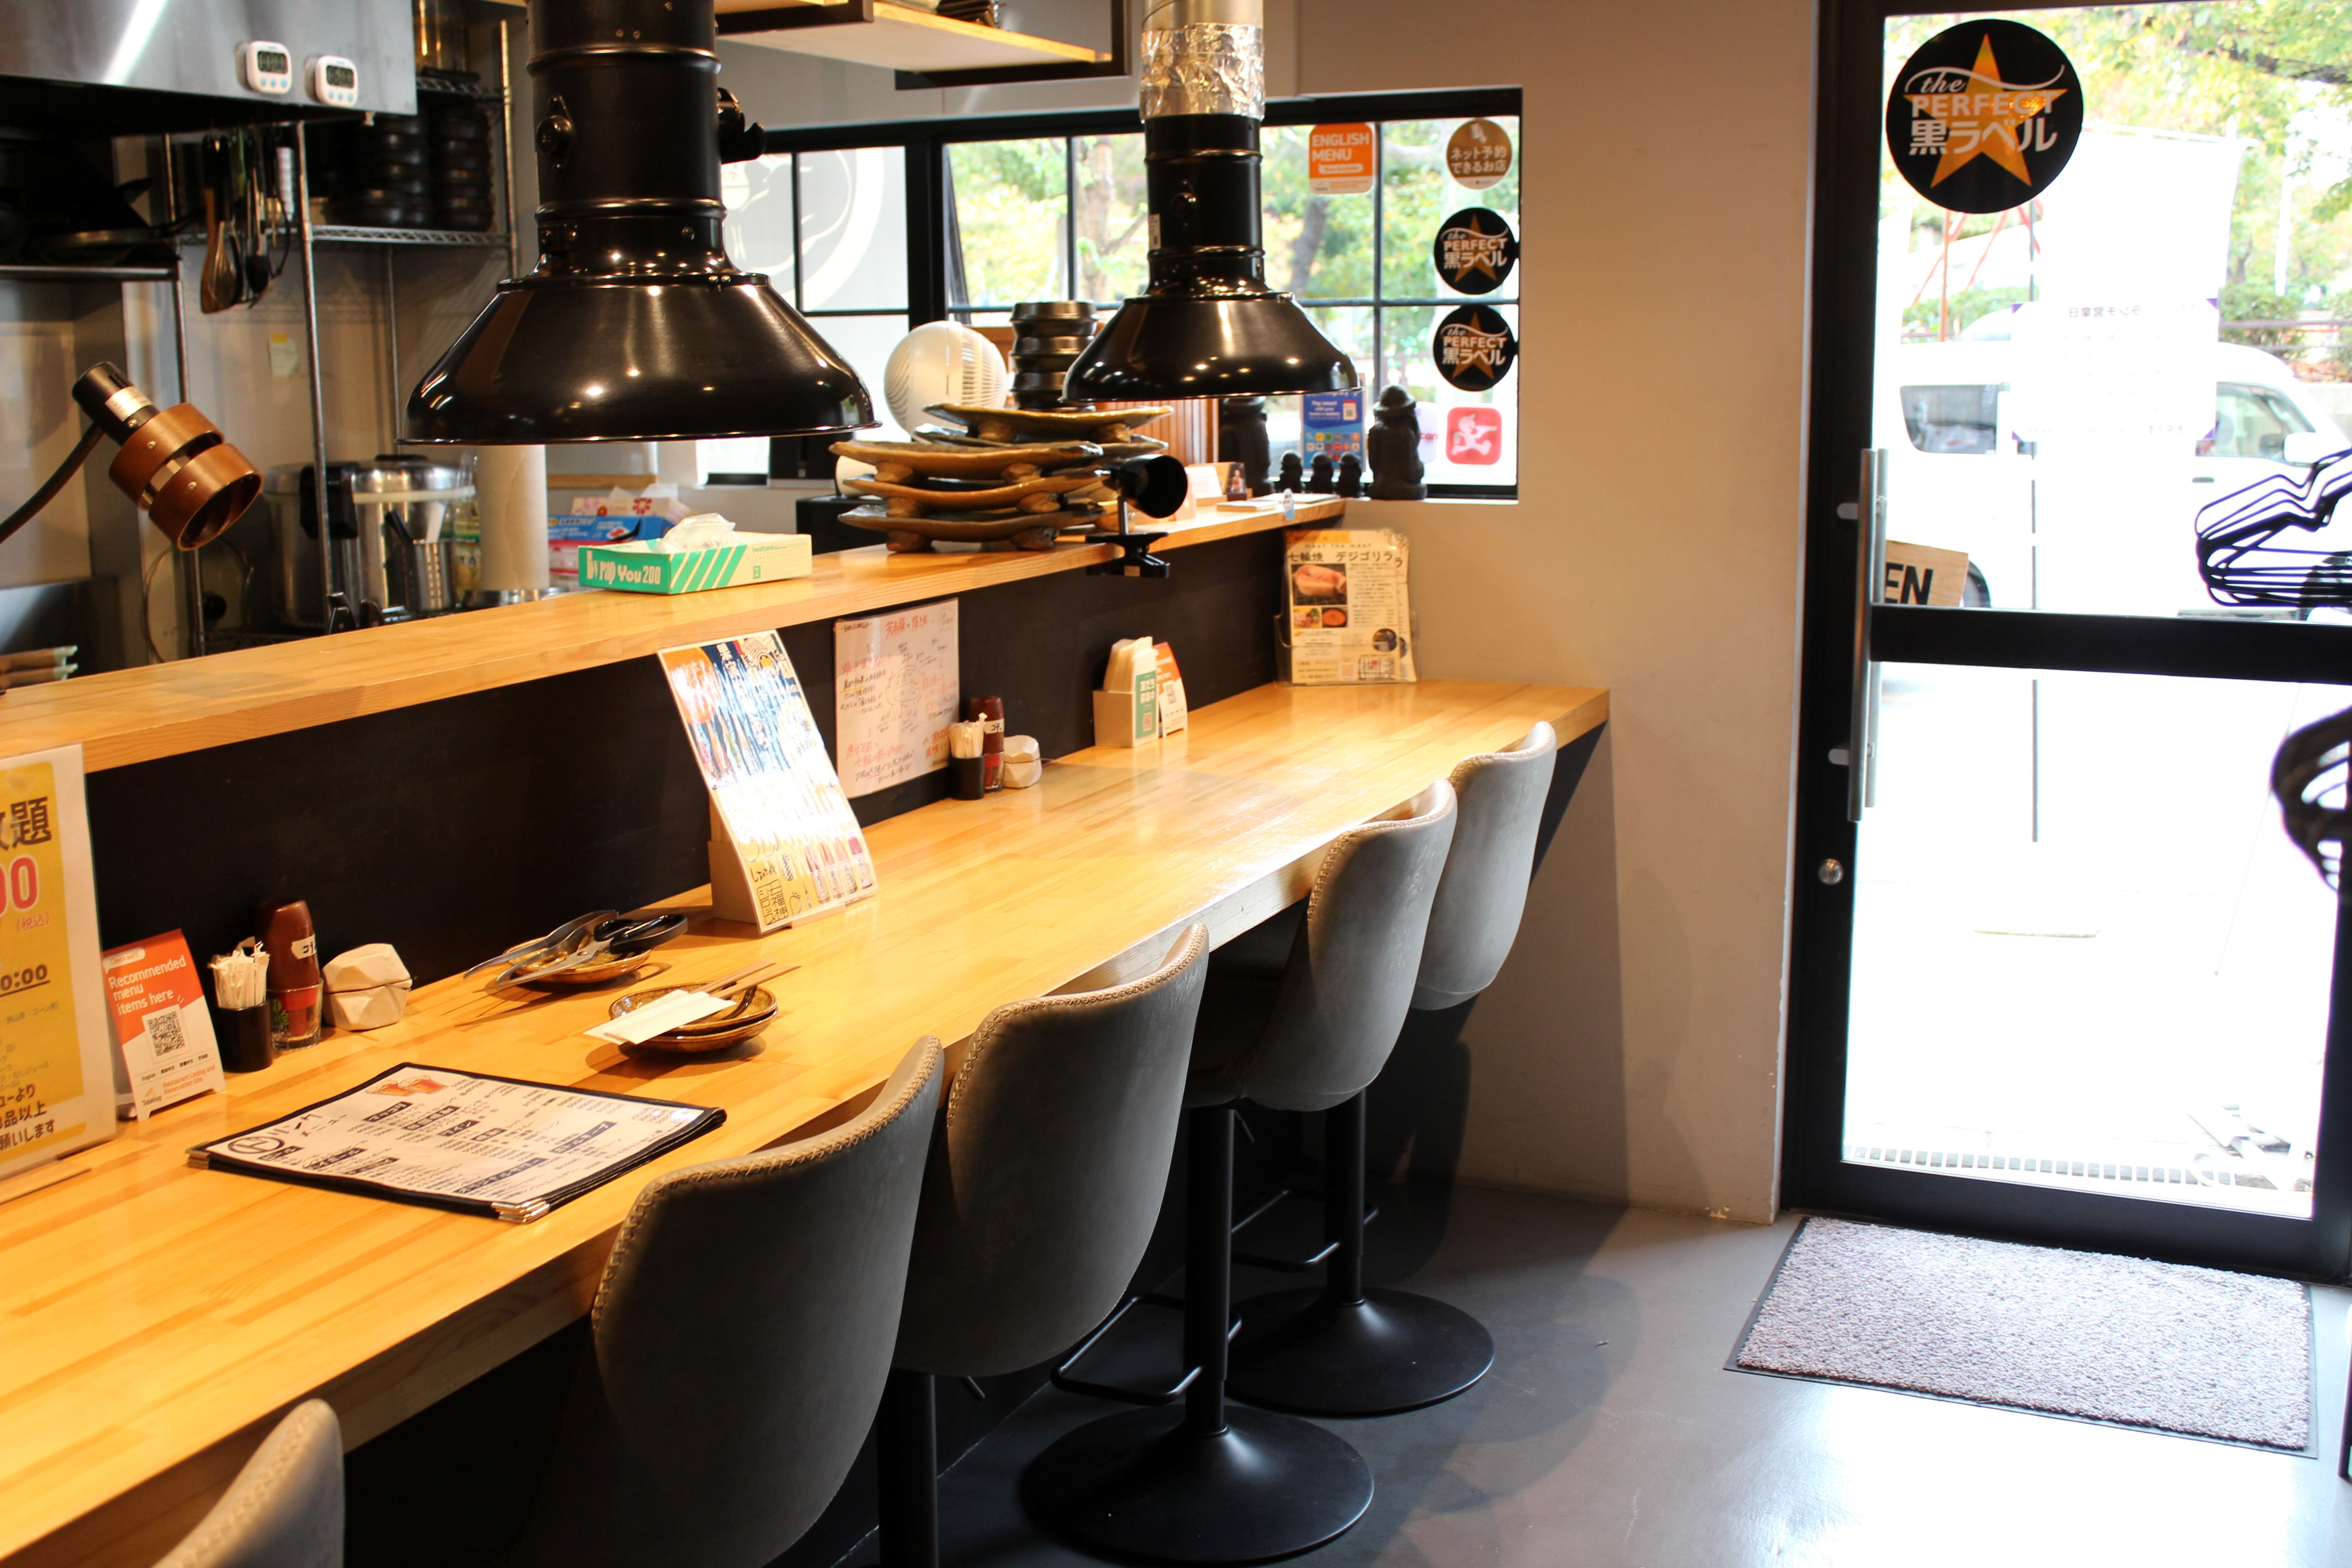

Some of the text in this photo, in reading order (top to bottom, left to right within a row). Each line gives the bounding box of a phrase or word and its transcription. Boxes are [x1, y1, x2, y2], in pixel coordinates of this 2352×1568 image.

[1921, 71, 1966, 93] the
[1912, 91, 2060, 118] PERFECT
[1312, 132, 1370, 147] ENGLISH
[1909, 118, 2058, 155] 黒ラベル
[1312, 147, 1352, 162] MENU
[1451, 145, 1507, 160] ネット予約
[1451, 159, 1506, 174] できるお店
[1443, 238, 1508, 251] PERFECT
[1447, 230, 1467, 240] the
[1444, 250, 1507, 270] 黒ラベル
[1447, 326, 1466, 336] the
[1442, 336, 1507, 348] PERFECT
[1442, 347, 1506, 366] 黒ラベル
[617, 565, 642, 583] You
[642, 565, 661, 584] 200
[0, 797, 52, 850] 題
[0, 857, 39, 914] 0
[17, 912, 50, 933] (税込)
[108, 955, 186, 990] Recommended
[113, 984, 144, 1001] menu
[117, 990, 174, 1015] items here
[163, 1064, 216, 1088] Restaurant Listing and
[164, 1081, 193, 1094] Reservation
